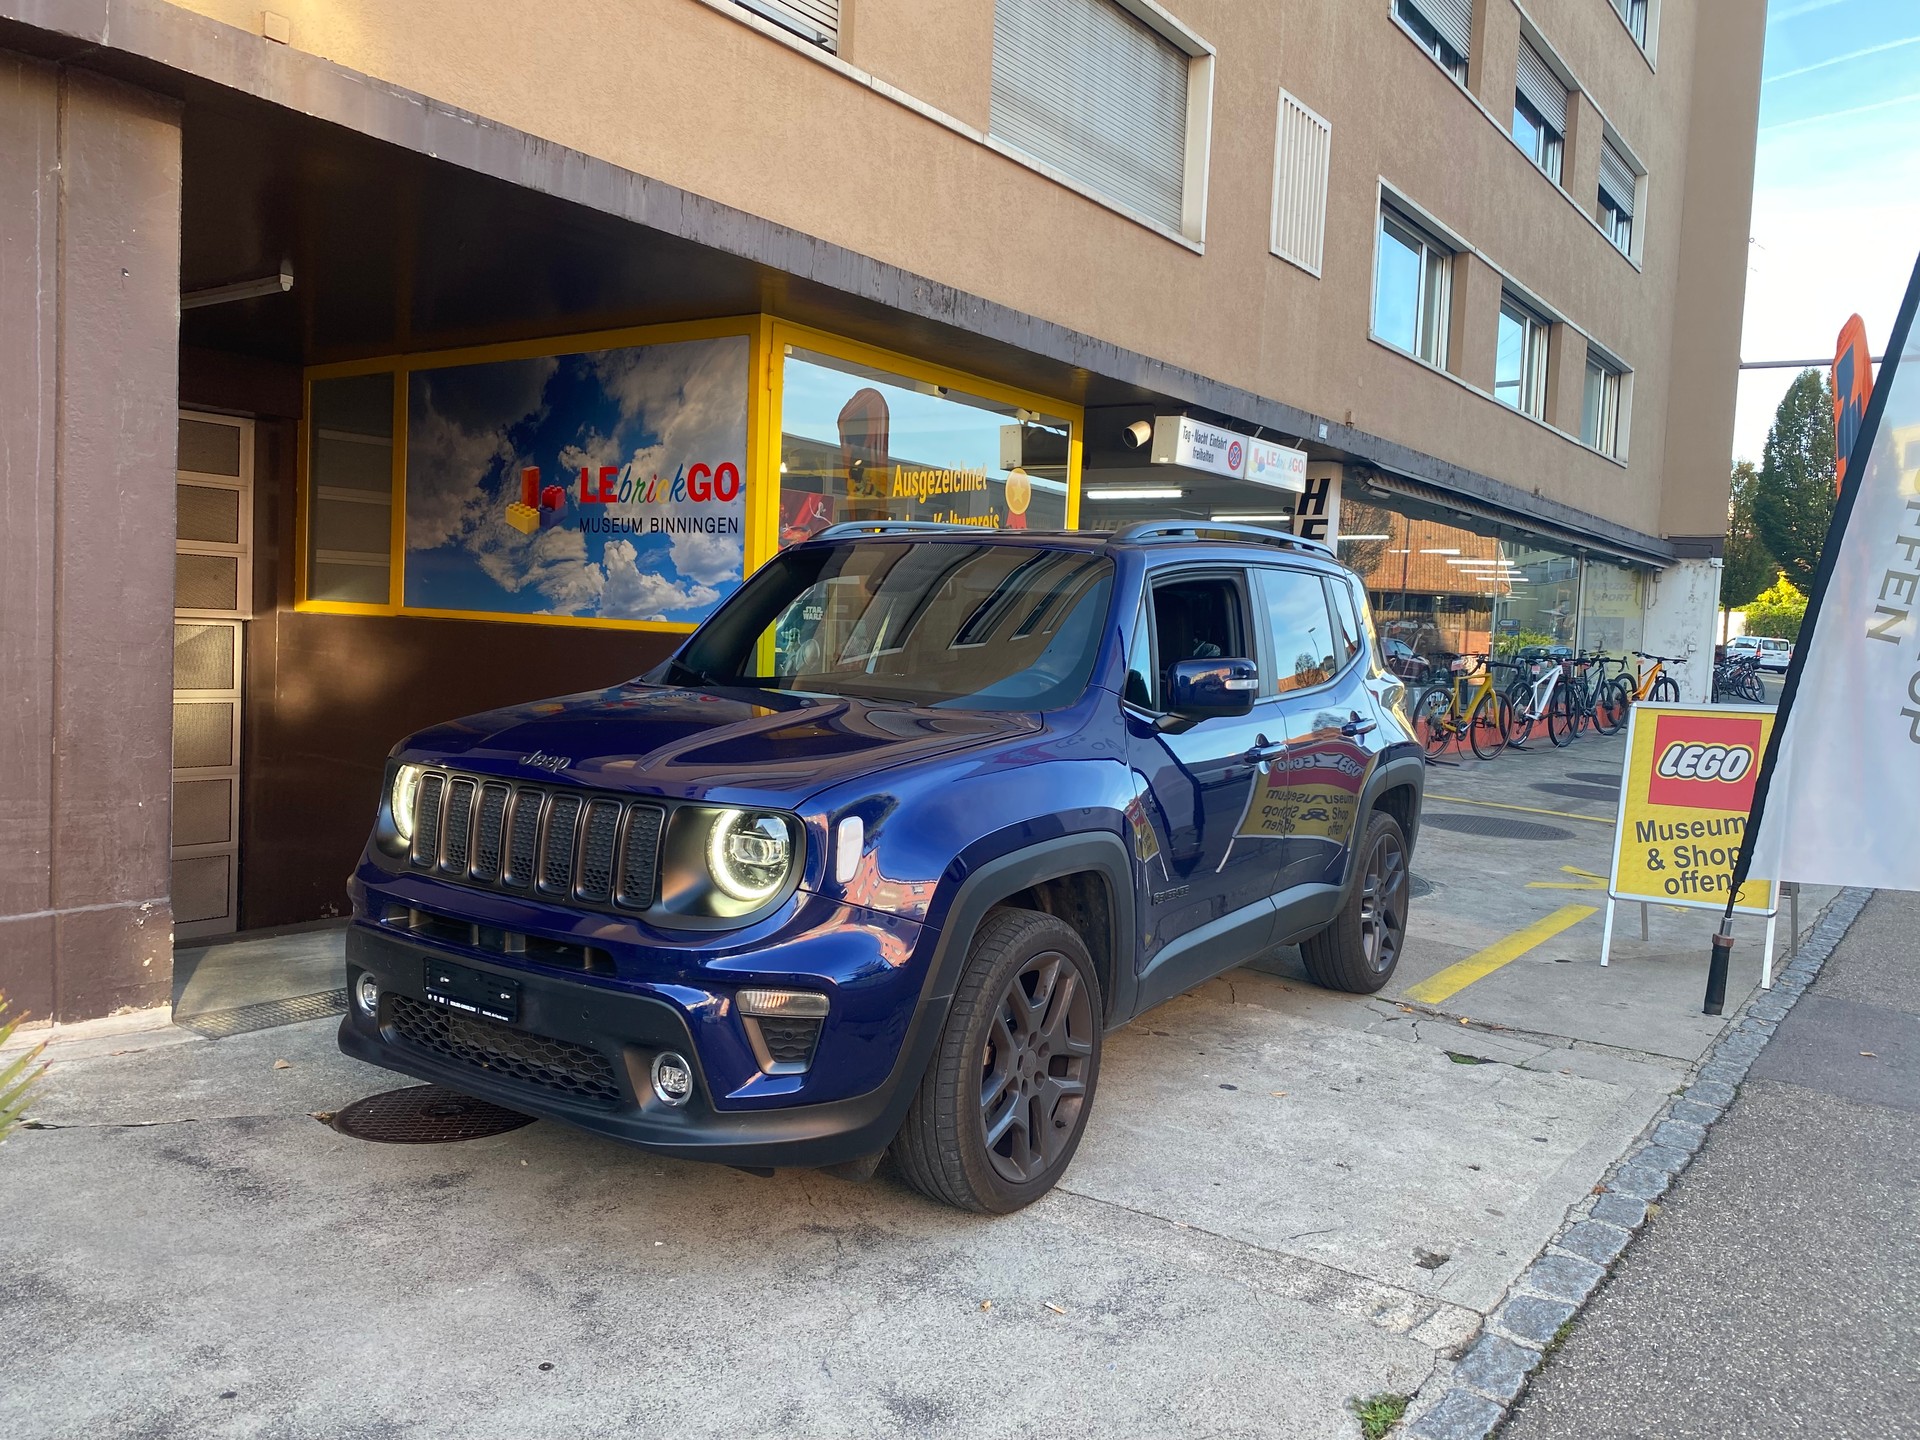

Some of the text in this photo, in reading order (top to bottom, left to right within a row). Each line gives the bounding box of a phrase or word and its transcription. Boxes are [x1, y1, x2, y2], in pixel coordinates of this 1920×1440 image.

[1183, 426, 1192, 443] Tag
[1194, 429, 1208, 445] Nacht
[1209, 433, 1228, 451] Einfahrt
[1192, 446, 1215, 463] freihalten
[580, 462, 740, 504] LEbrickGO
[892, 461, 988, 504] Ausgezeichnet
[579, 517, 739, 534] MUSEUM BINNINGEN
[803, 612, 824, 621] WARS
[519, 749, 572, 774] Jeep
[1657, 742, 1753, 782] LEGO
[1635, 815, 1747, 843] Museum
[1646, 844, 1741, 871] & Shop
[1664, 869, 1732, 895] offen
